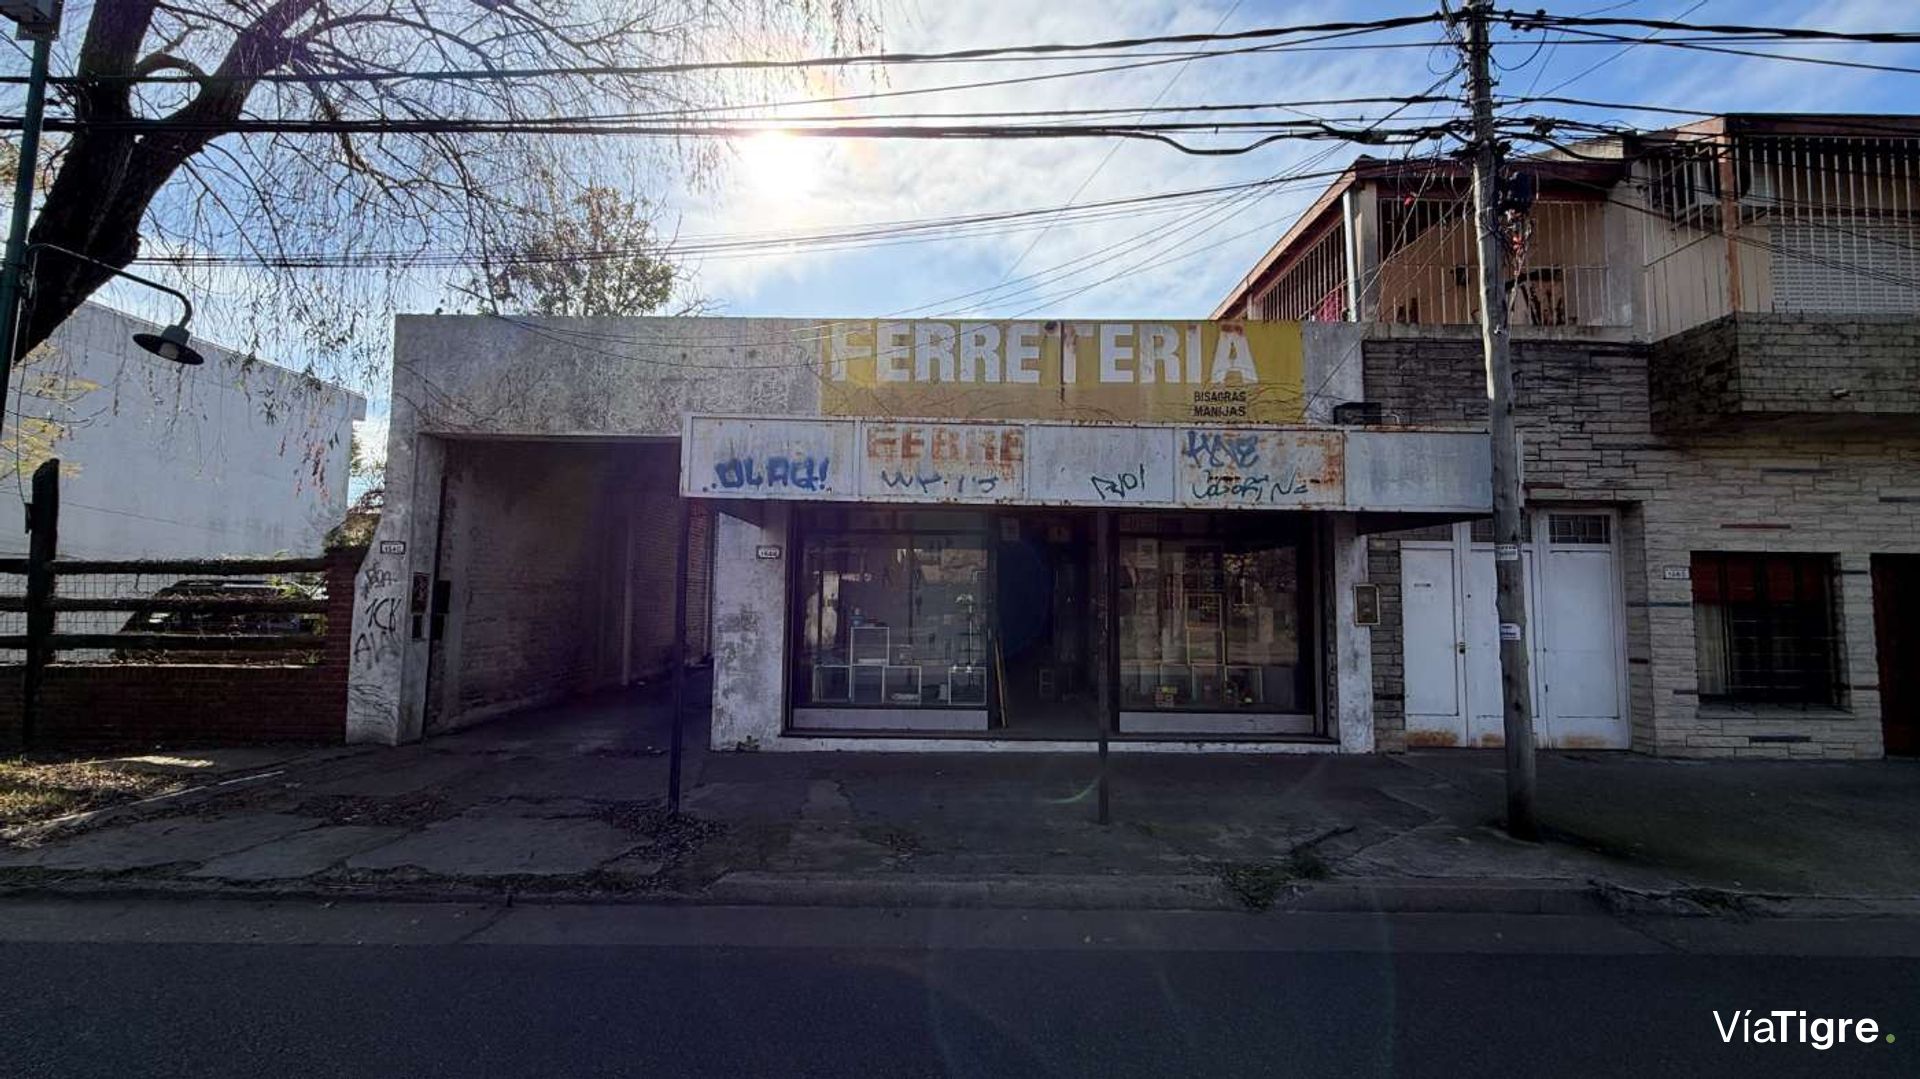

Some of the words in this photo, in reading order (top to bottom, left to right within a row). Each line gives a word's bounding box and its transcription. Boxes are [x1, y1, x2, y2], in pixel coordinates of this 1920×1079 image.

[829, 323, 1258, 384] FERRETERIA
[1194, 391, 1247, 402] BISAGRAS
[1194, 406, 1247, 417] MANIJAS
